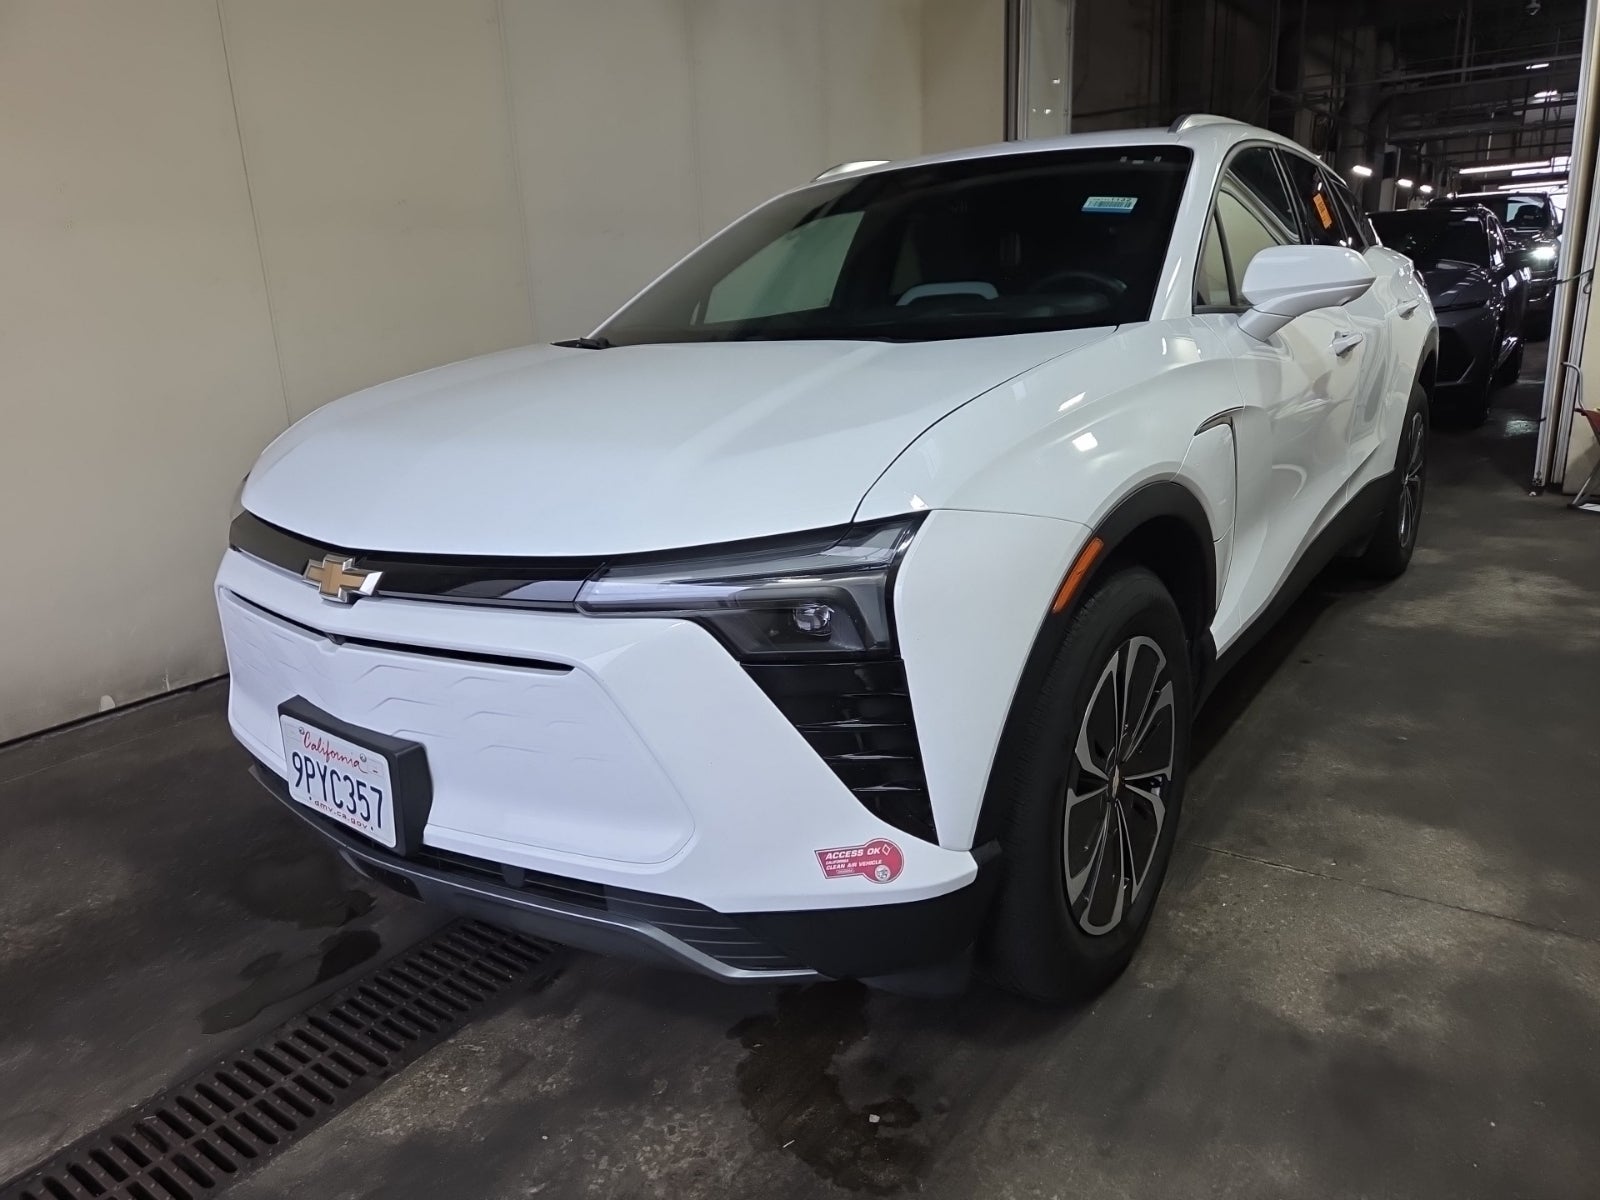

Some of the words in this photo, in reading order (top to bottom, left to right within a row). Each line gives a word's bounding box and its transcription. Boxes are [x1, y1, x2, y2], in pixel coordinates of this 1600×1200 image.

[303, 731, 368, 773] California
[292, 751, 383, 829] 9PYC357
[314, 800, 368, 829] dmv.ca.gov
[825, 849, 864, 860] ACCESS
[867, 847, 881, 856] OK
[826, 863, 845, 871] CLEAN
